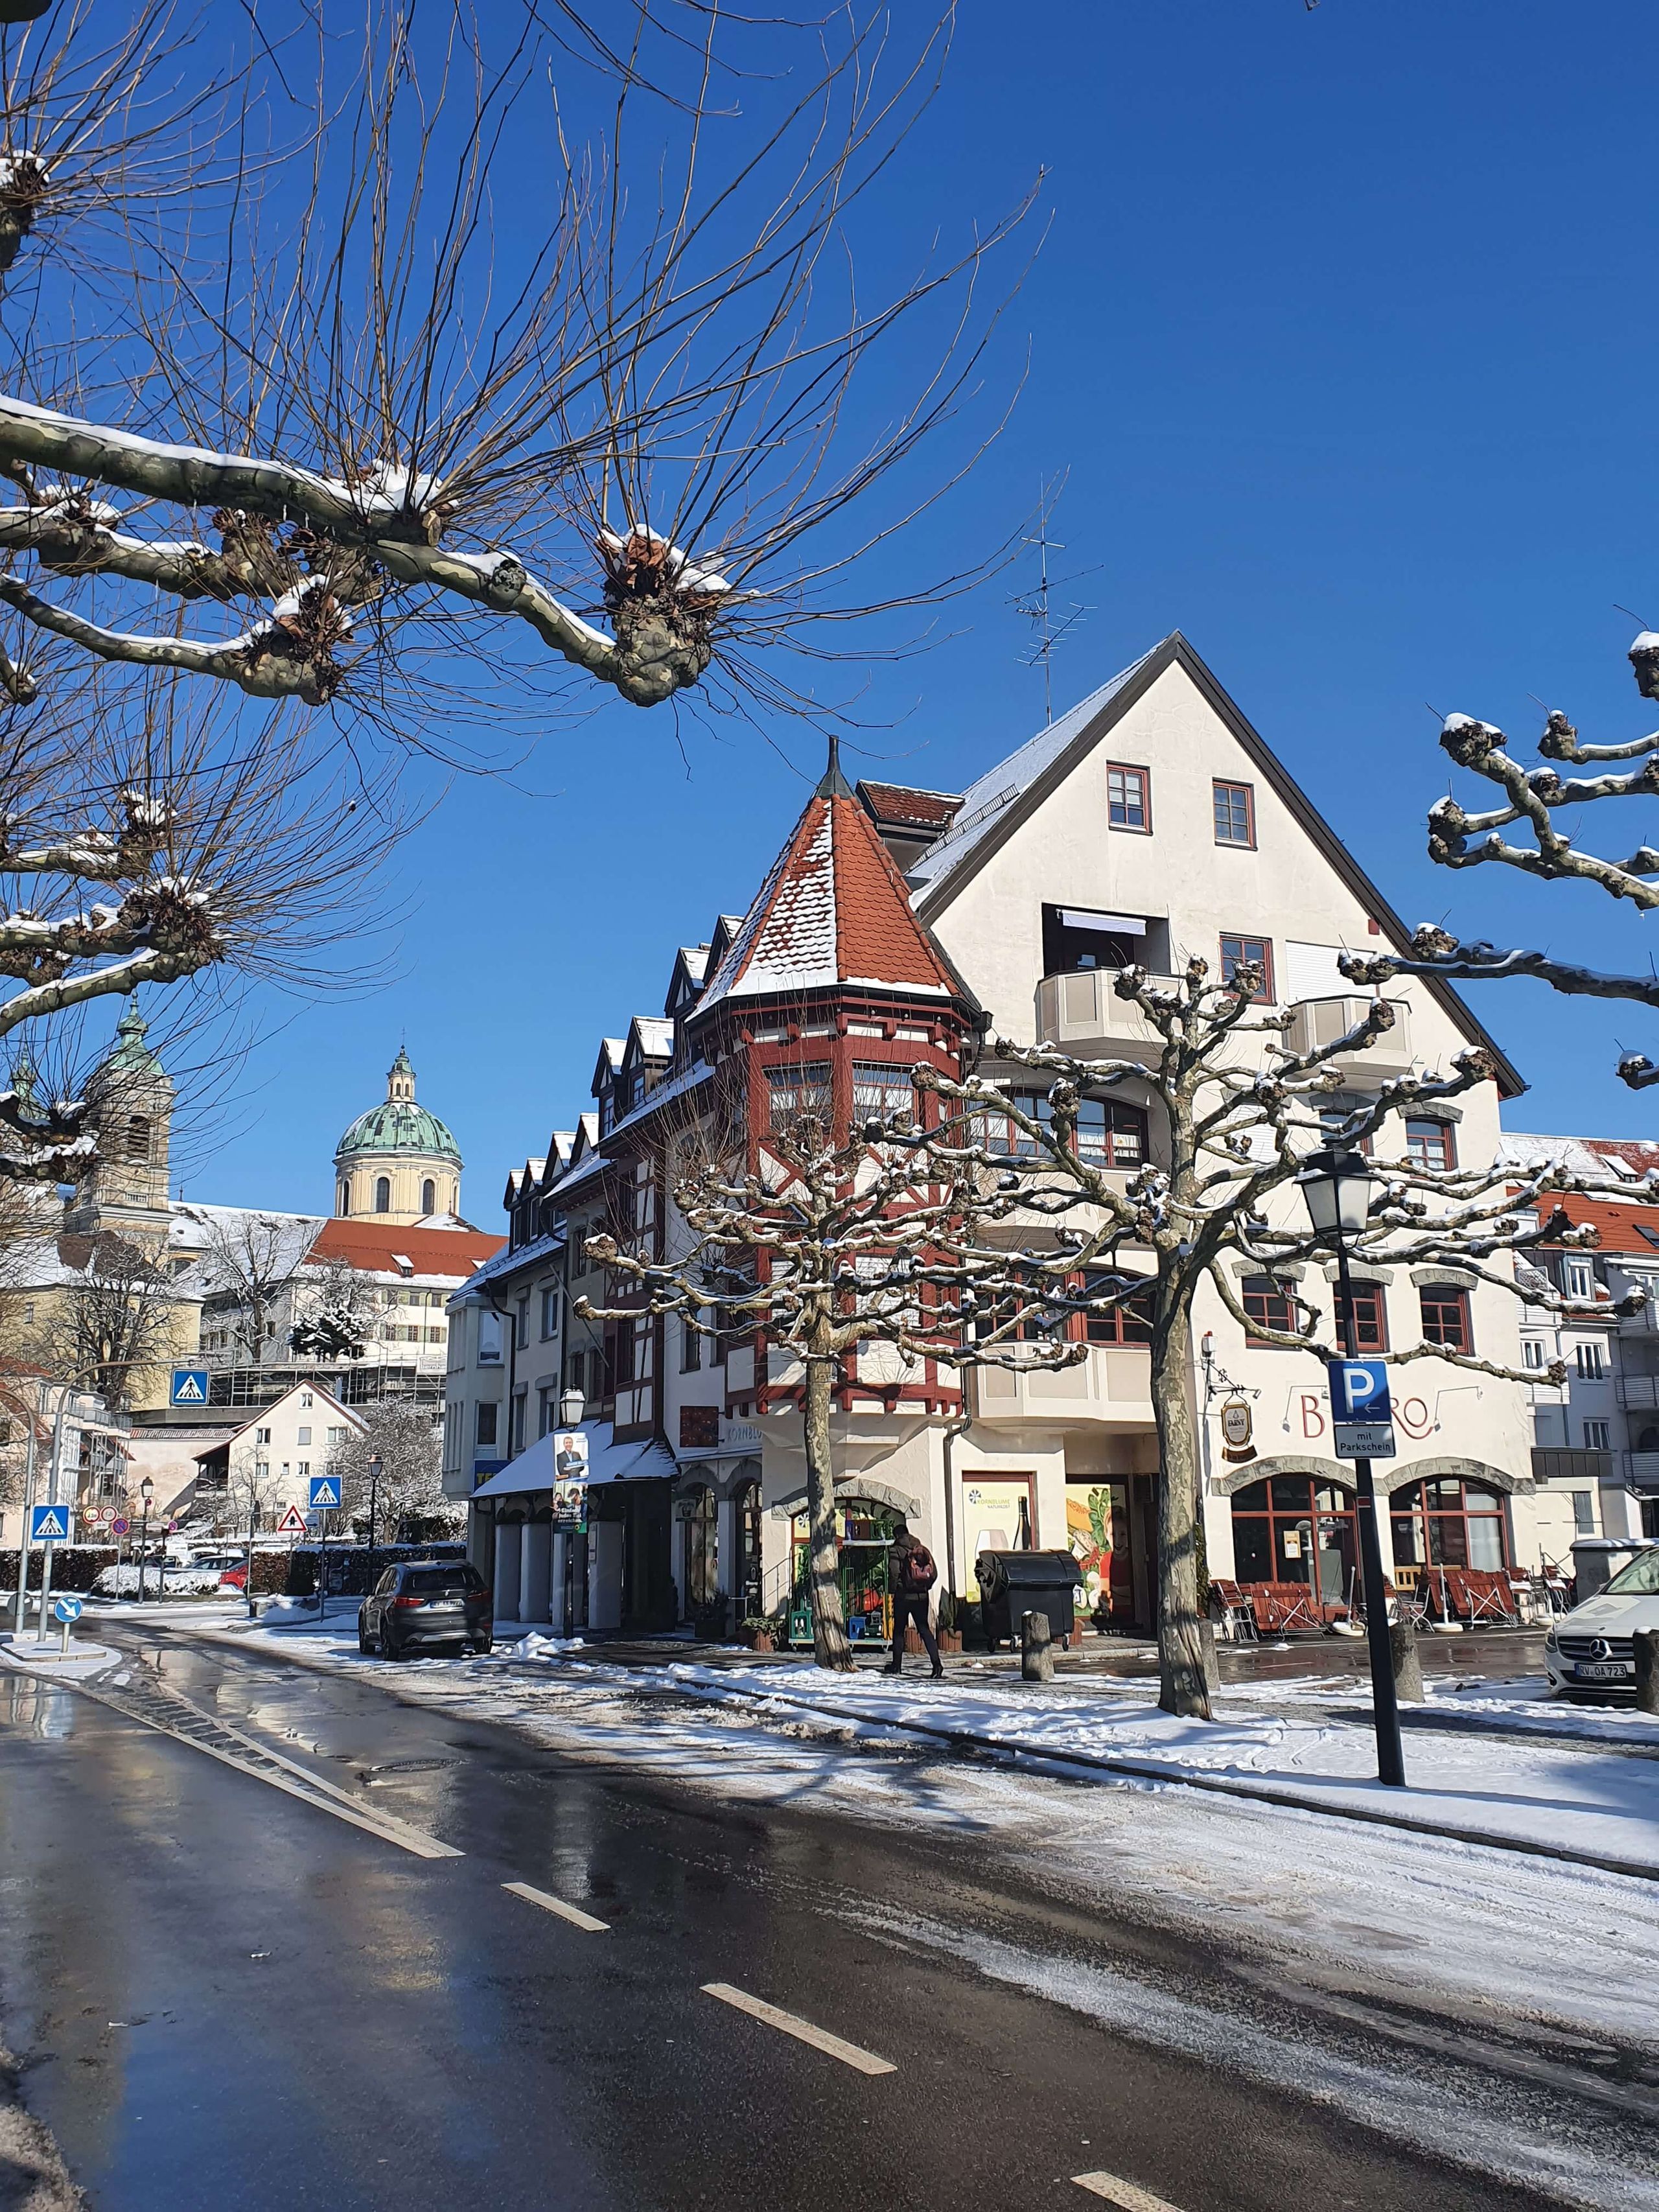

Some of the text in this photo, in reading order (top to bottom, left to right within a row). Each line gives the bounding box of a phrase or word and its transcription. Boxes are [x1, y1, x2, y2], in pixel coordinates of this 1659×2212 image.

[1343, 1368, 1375, 1414] P
[1357, 1432, 1372, 1441] mit
[1340, 1443, 1391, 1452] Parkschein
[1607, 1667, 1625, 1677] 723
